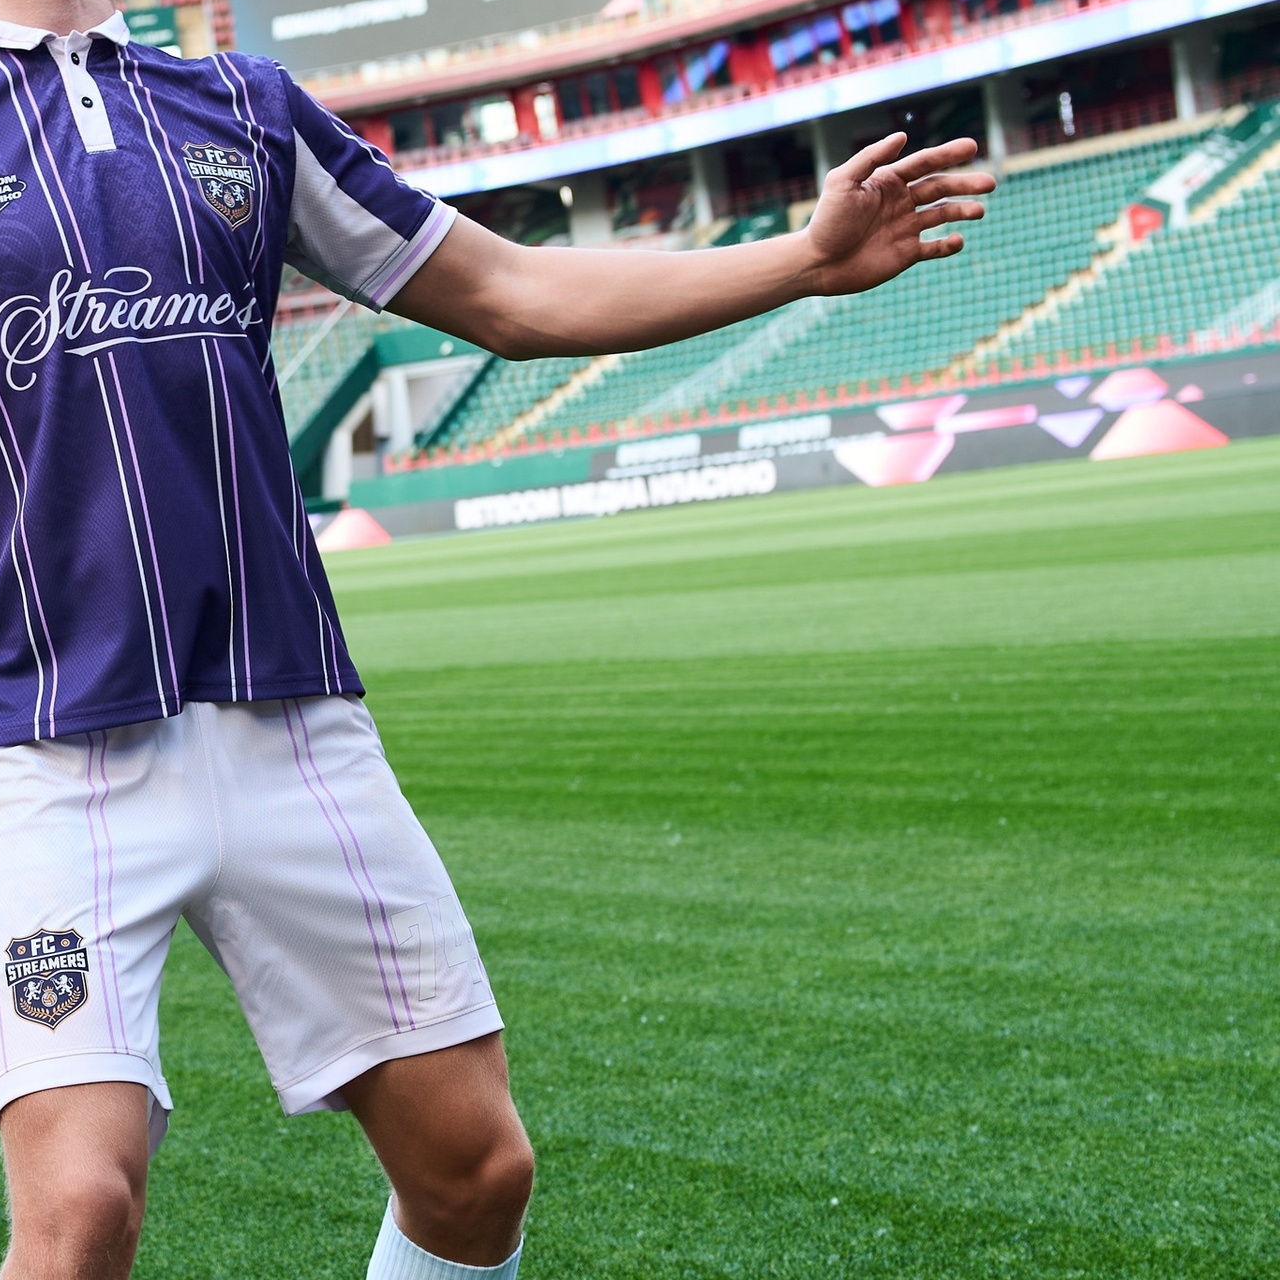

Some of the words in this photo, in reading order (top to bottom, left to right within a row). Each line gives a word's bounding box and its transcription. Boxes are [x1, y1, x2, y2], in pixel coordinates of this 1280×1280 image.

[204, 148, 228, 165] FC
[188, 162, 252, 185] STREAMERS
[30, 935, 56, 956] FC
[7, 951, 87, 982] STREAMERS
